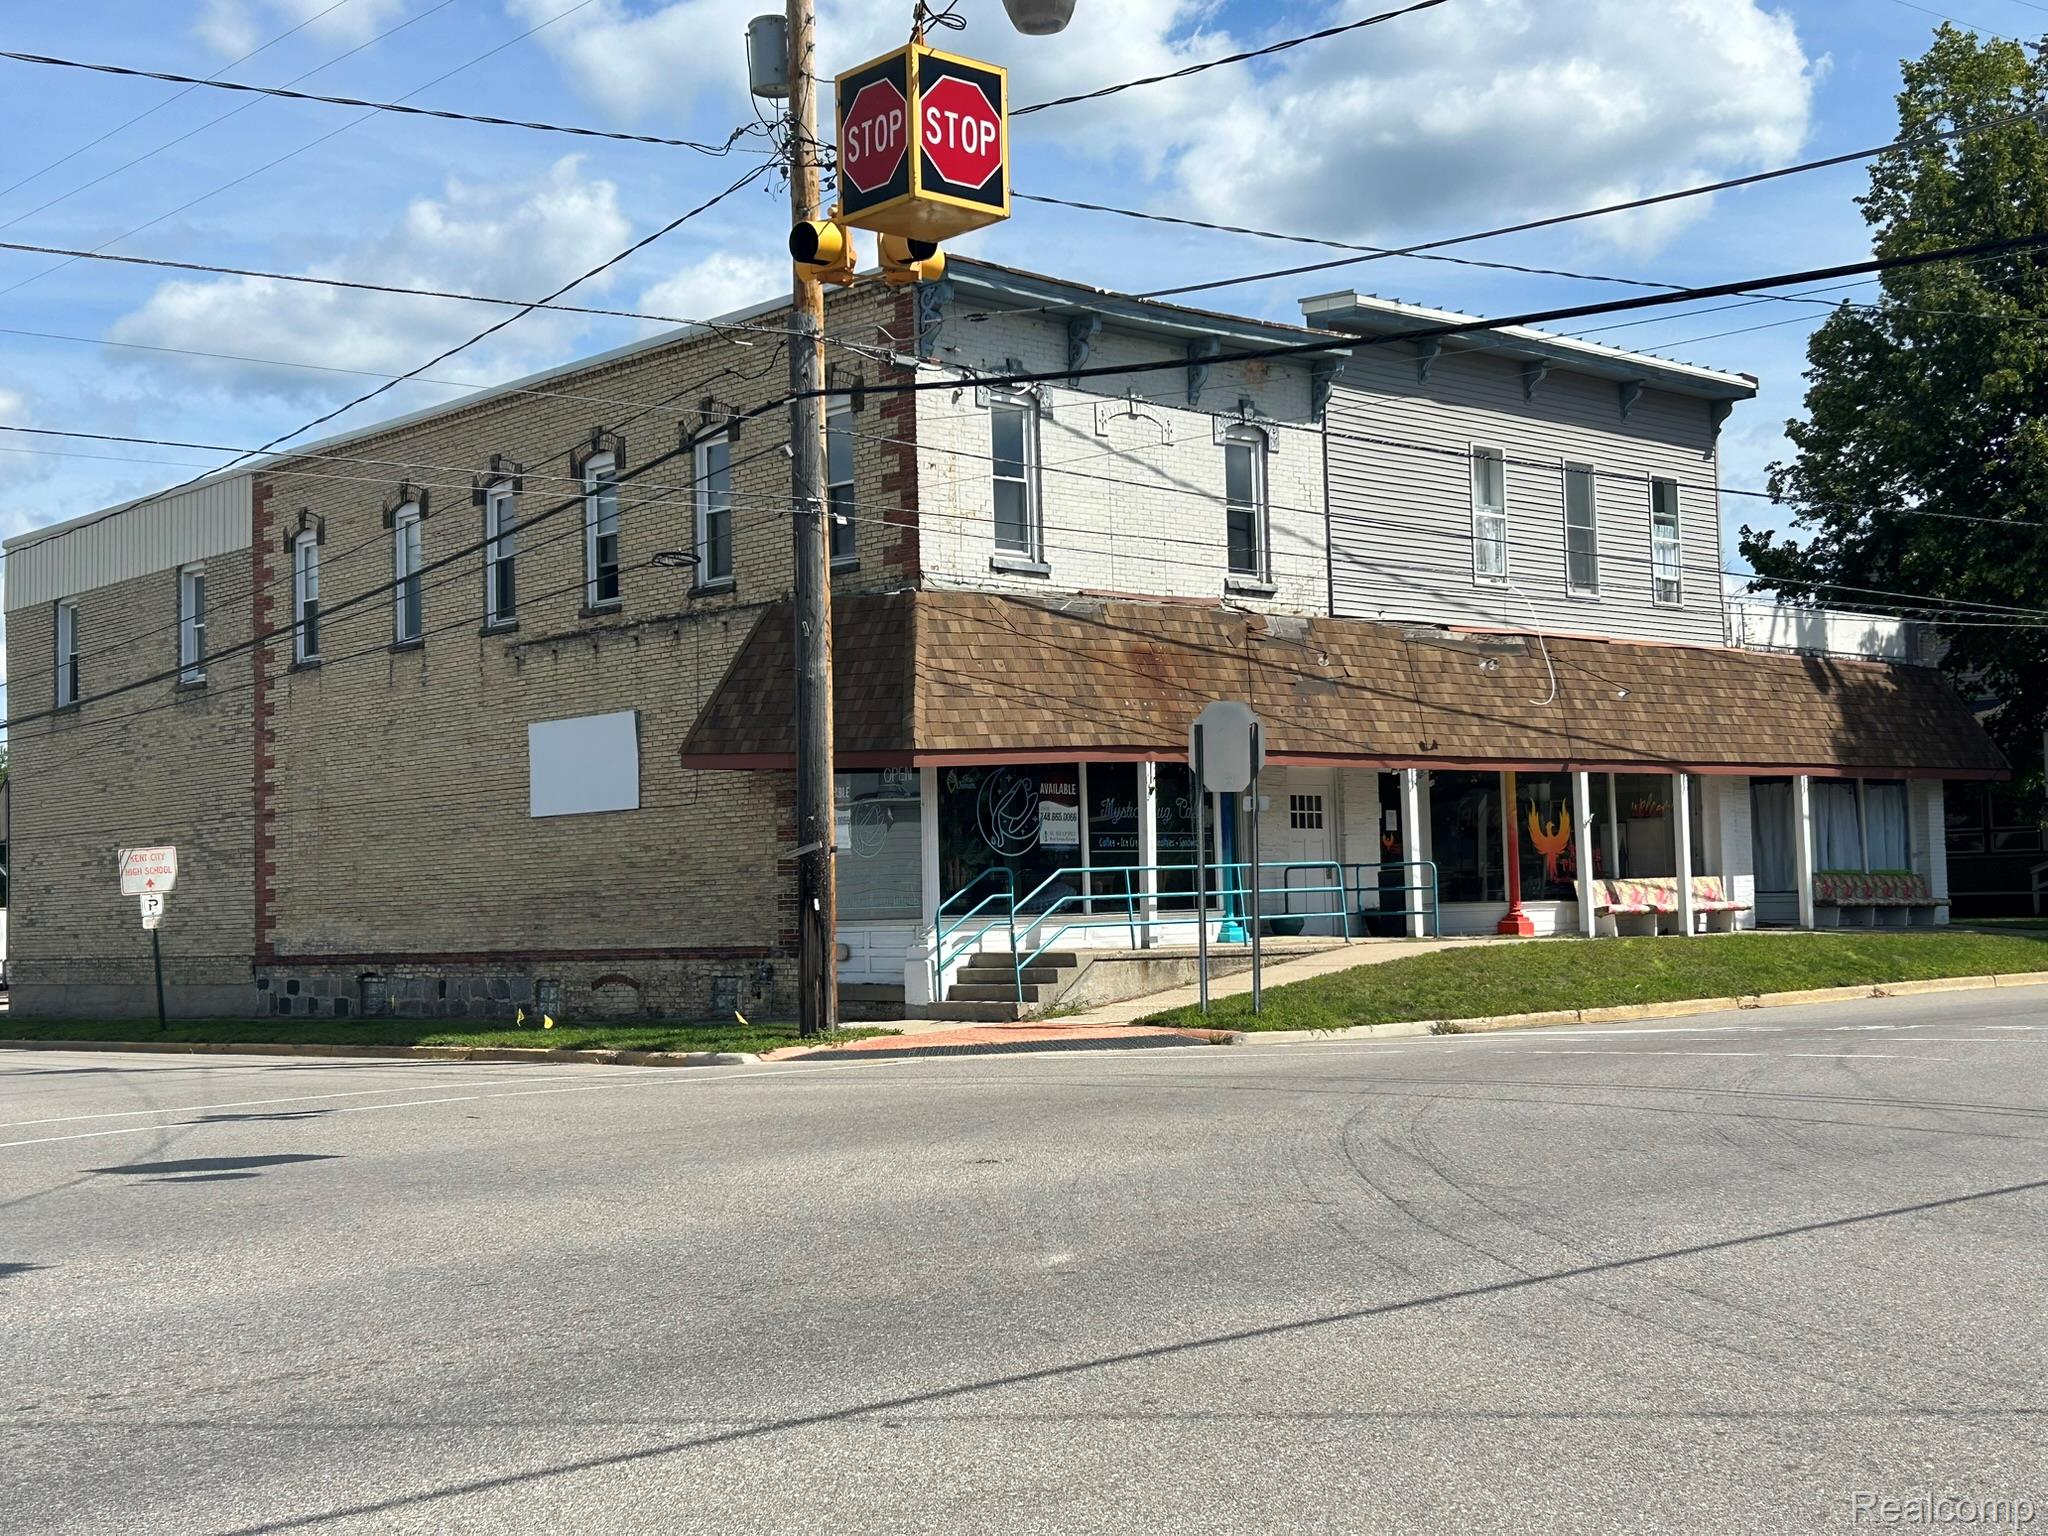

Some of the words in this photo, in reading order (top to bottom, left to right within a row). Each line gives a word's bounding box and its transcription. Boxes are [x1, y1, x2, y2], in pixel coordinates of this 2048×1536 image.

[848, 108, 902, 163] STOP
[926, 106, 996, 156] STOP
[883, 767, 913, 783] OPEN
[1040, 782, 1077, 795] AVAILABLE
[130, 854, 148, 862] KENT
[150, 853, 165, 862] CITY
[125, 868, 142, 876] HIGH
[144, 866, 172, 875] SCHOOL
